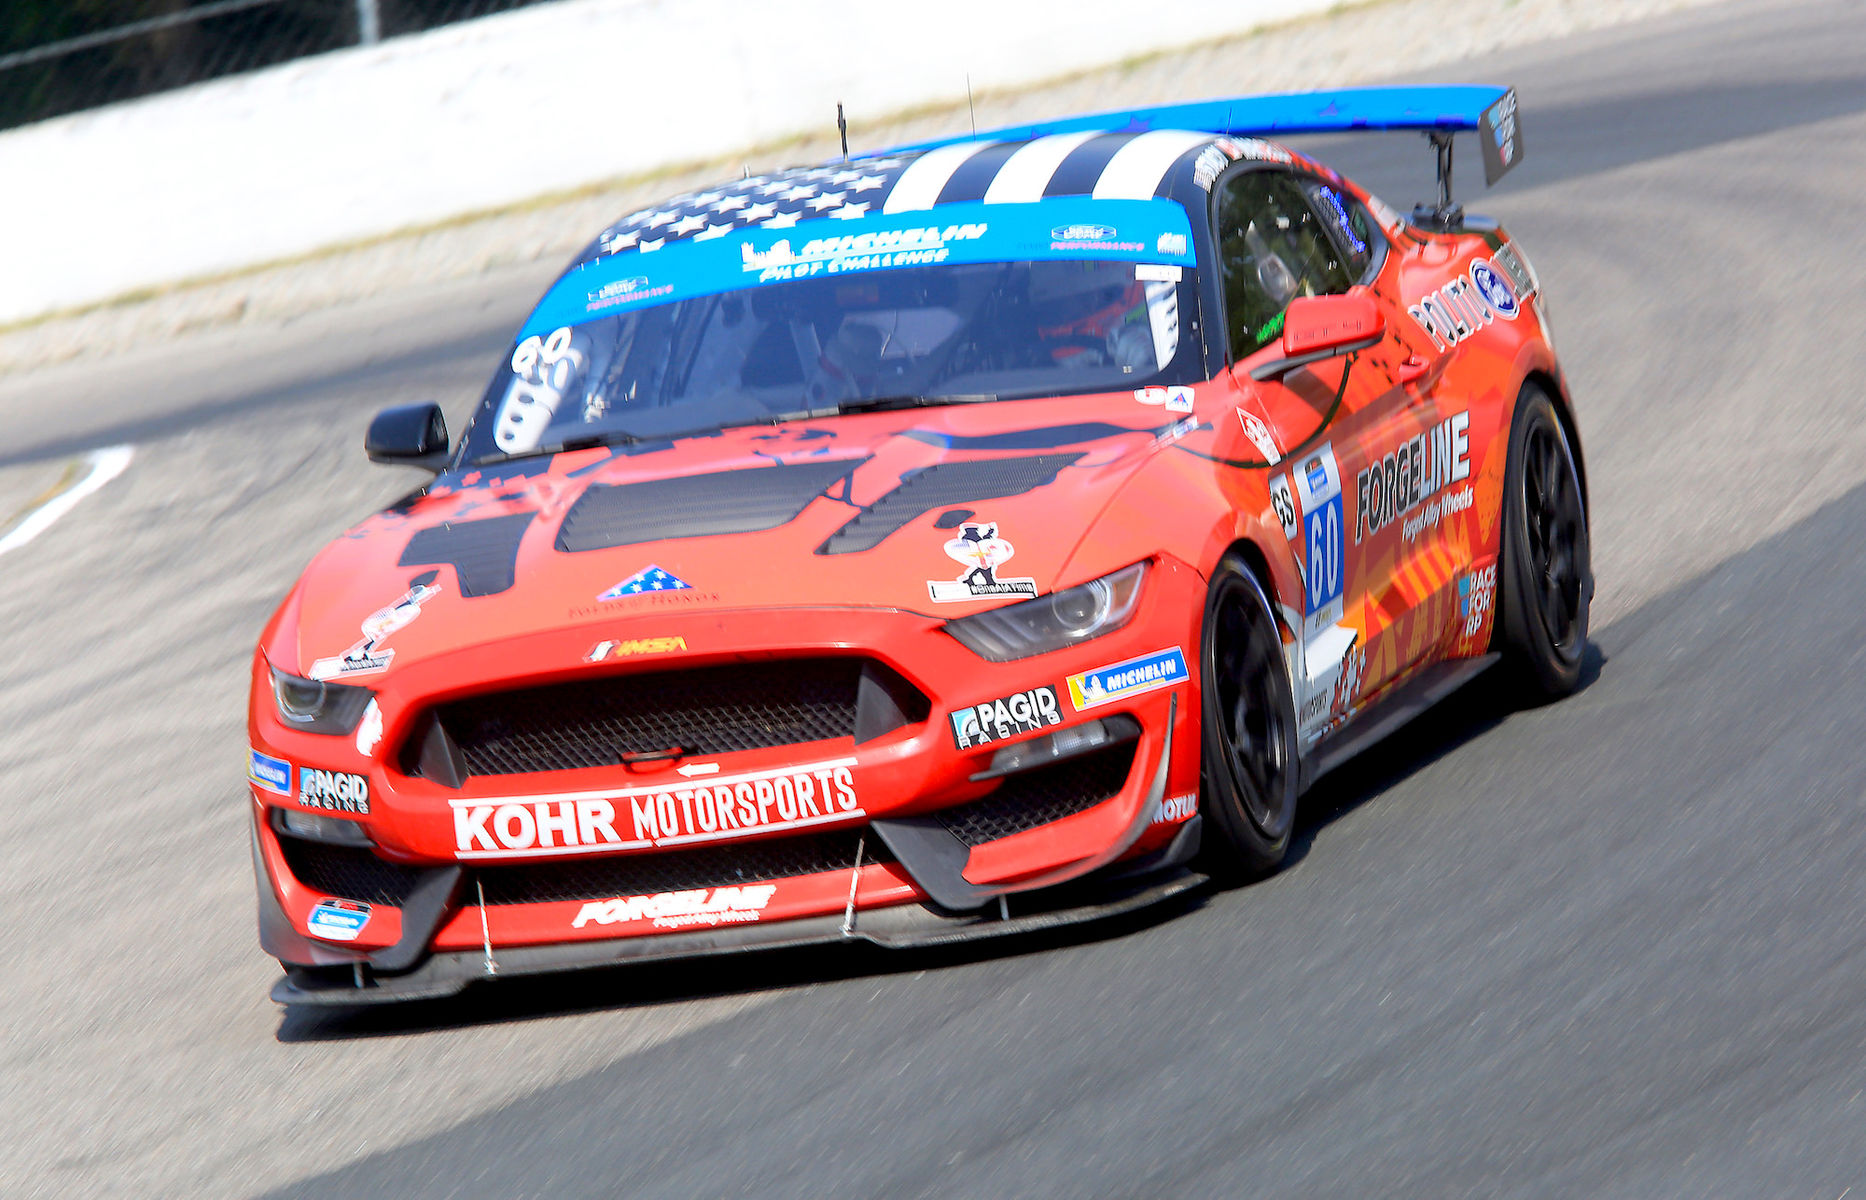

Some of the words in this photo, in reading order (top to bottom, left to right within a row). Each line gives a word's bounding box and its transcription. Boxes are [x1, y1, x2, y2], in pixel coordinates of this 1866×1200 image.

[802, 223, 988, 256] MICHELIN
[759, 263, 823, 282] PILOT
[828, 248, 949, 273] CHALLENGE
[1355, 410, 1470, 547] FORGELINE
[1273, 488, 1293, 528] GS
[1441, 485, 1473, 517] Wheels
[1311, 501, 1338, 609] 60
[1470, 564, 1497, 592] RACE
[1469, 590, 1490, 614] FOR
[1465, 612, 1483, 637] RP
[1106, 659, 1176, 692] MICHELIN
[978, 687, 1057, 732] PAGID
[958, 711, 1061, 750] RACING
[298, 791, 369, 815] RACING
[314, 769, 369, 803] PAGID
[455, 798, 621, 851] KOHR
[630, 767, 858, 840] MOTORSPORTS
[1151, 793, 1198, 824] MOTUL
[571, 884, 777, 929] FORGELINE
